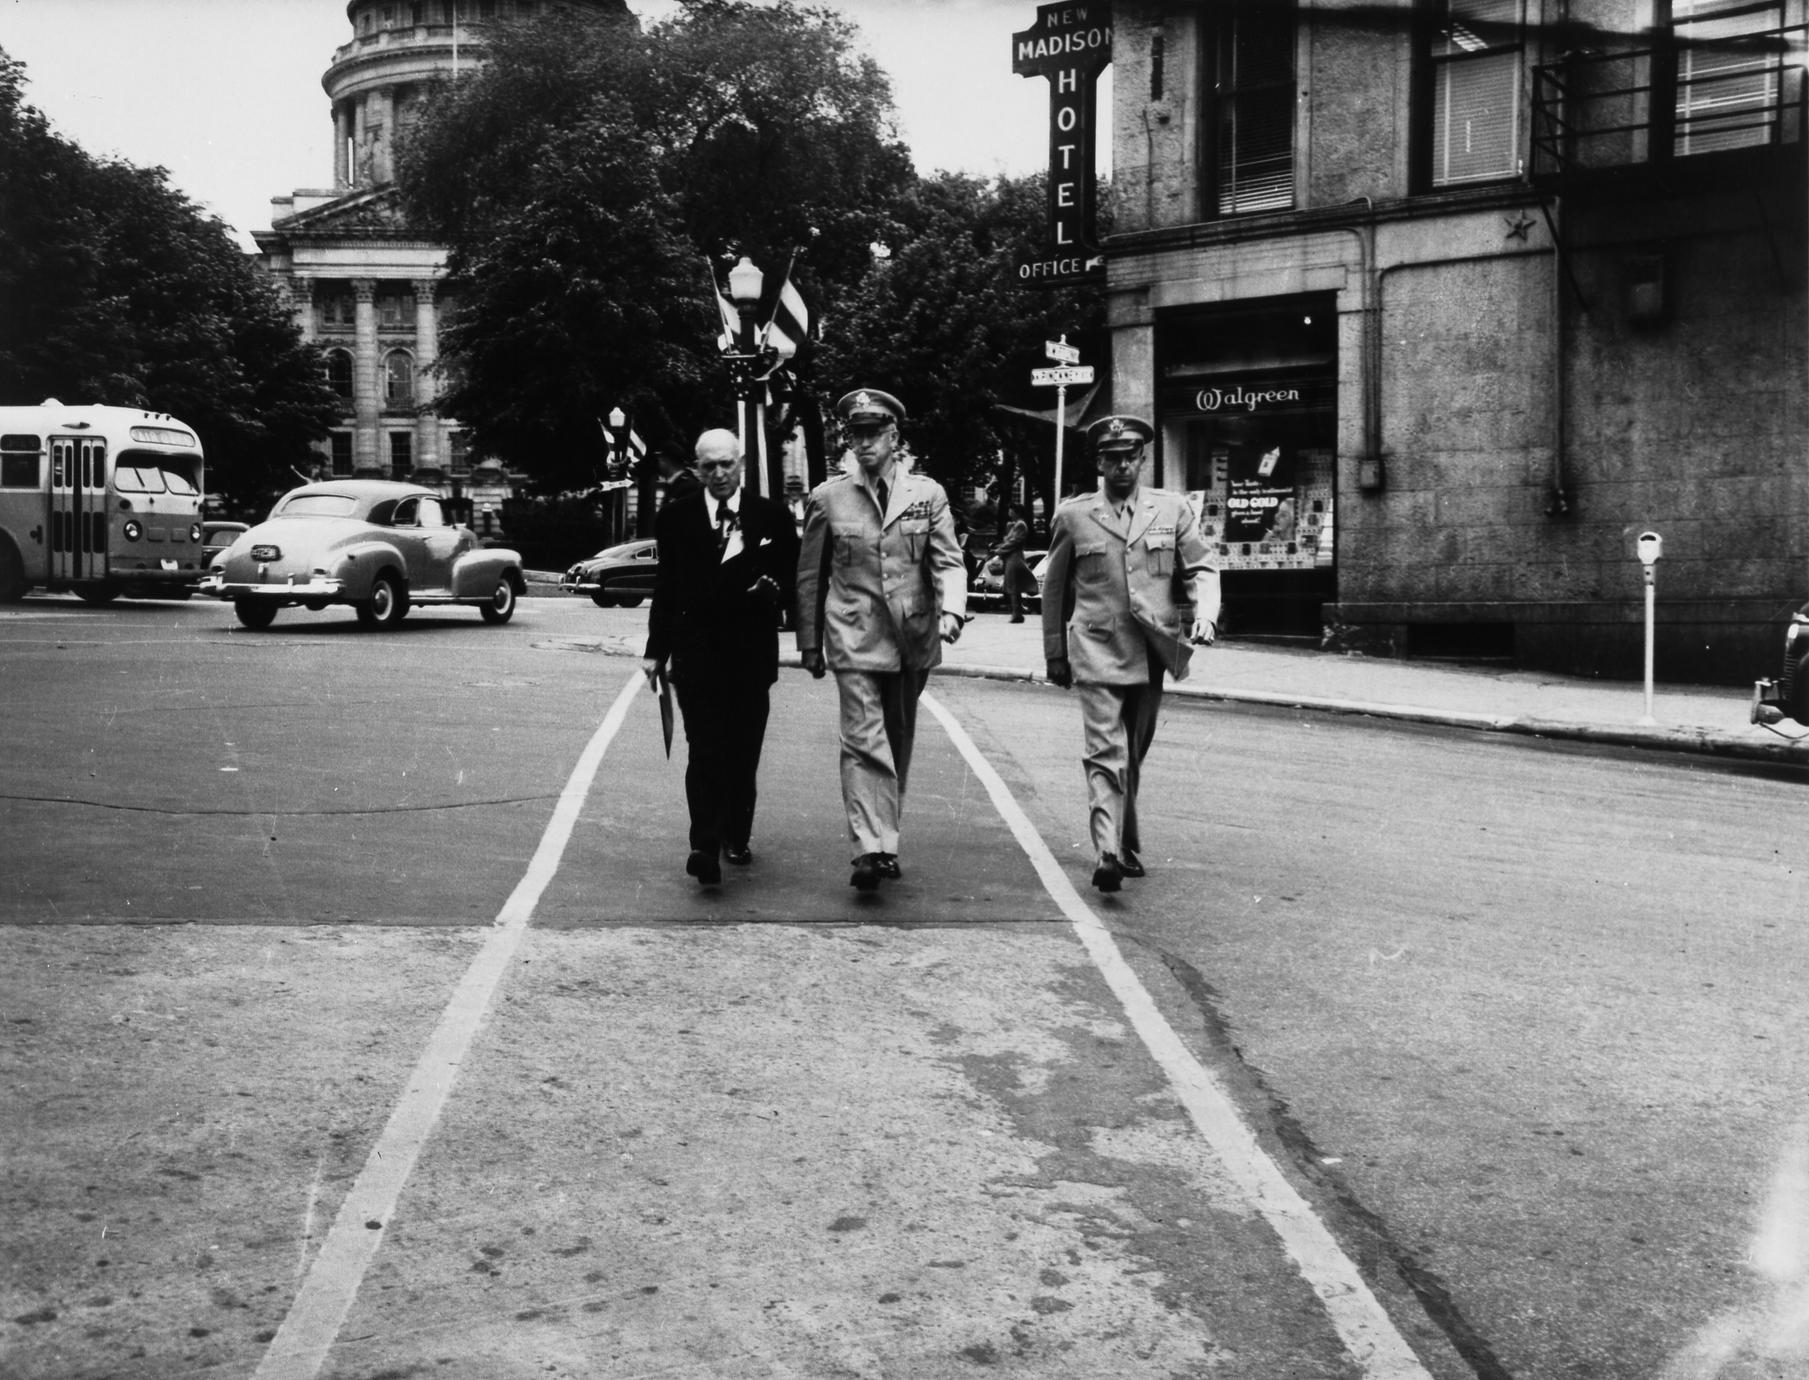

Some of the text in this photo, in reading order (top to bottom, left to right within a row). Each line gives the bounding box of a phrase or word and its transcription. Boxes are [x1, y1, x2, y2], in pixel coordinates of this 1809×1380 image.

[1047, 7, 1088, 28] NEW
[1057, 68, 1077, 245] HOTEL
[1019, 258, 1081, 278] OFFICE
[1196, 386, 1299, 411] Walgreen
